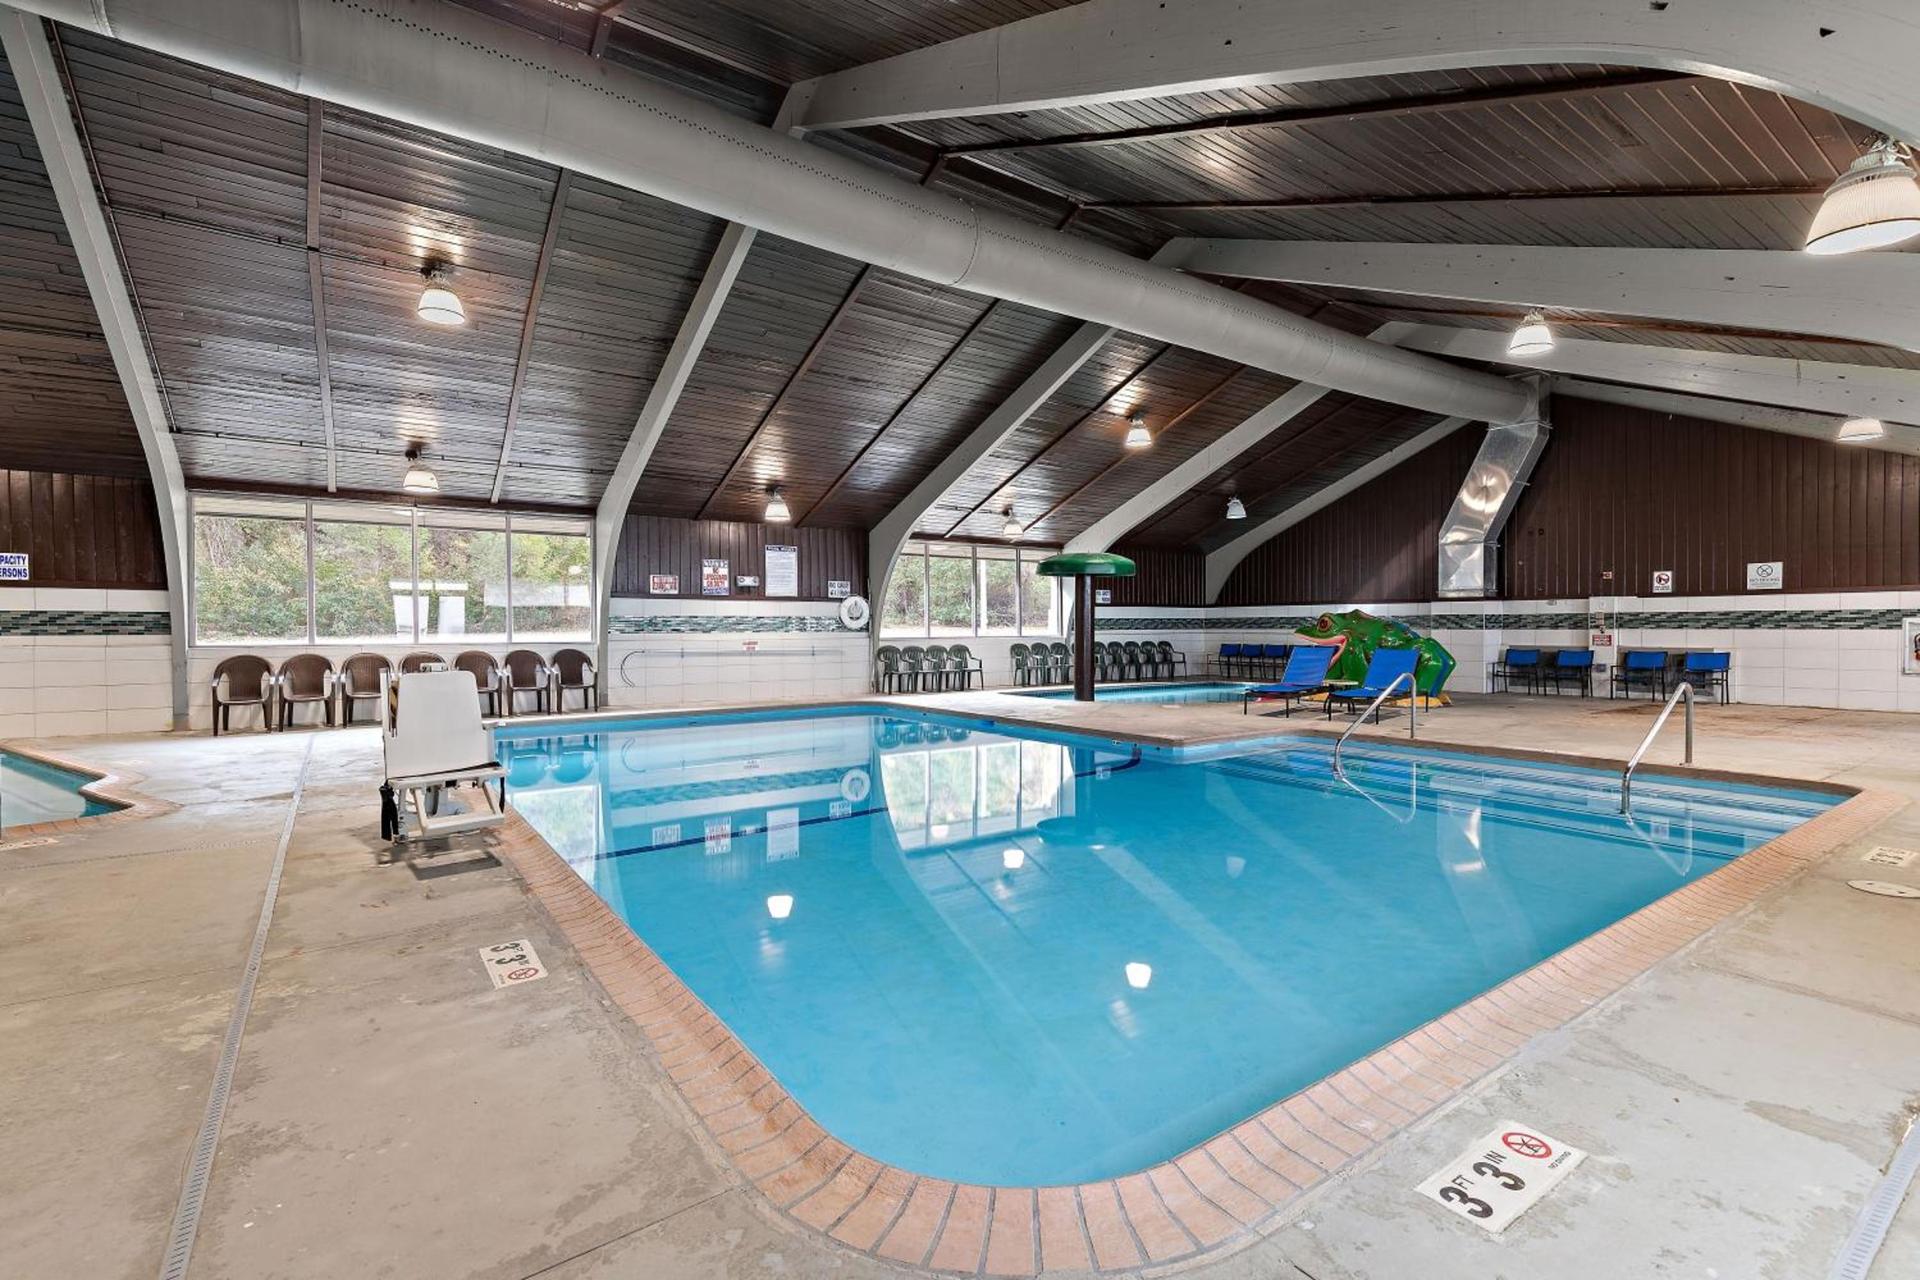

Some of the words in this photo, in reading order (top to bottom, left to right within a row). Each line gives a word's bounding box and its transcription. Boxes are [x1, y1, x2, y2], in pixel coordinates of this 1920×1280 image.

[1483, 1150, 1507, 1164] IN
[1452, 1174, 1474, 1190] FT
[1473, 1161, 1525, 1191] 3
[1439, 1186, 1493, 1218] 3
